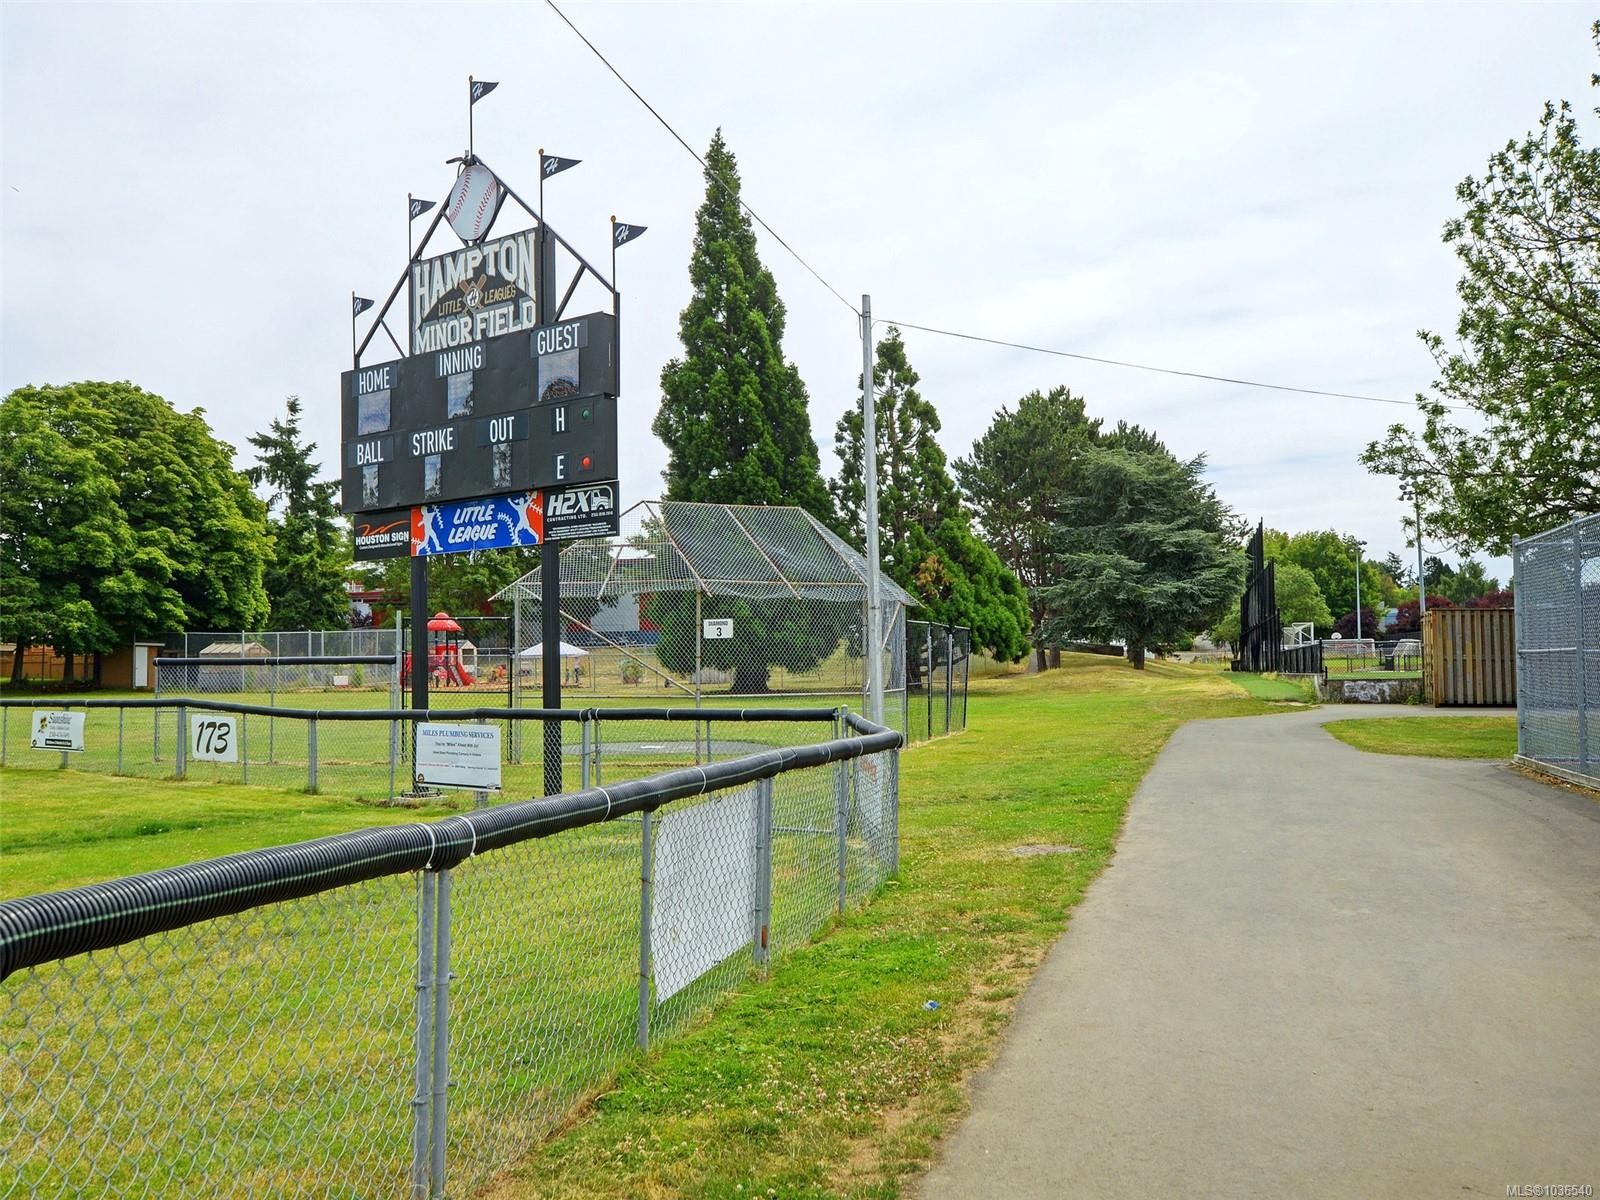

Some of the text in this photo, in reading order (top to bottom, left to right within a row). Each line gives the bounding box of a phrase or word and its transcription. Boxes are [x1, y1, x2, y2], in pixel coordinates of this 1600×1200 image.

[413, 230, 537, 330] HAMPTON
[438, 298, 462, 316] LITTLE
[414, 299, 537, 355] MINOR FIELD
[537, 323, 581, 355] GUEST
[440, 346, 482, 377] INNING
[359, 367, 391, 395] HOME
[489, 416, 515, 443] OUT
[555, 407, 565, 432] H
[357, 440, 384, 465] BALL
[412, 427, 454, 456] STRIKE
[556, 455, 565, 480] E
[453, 504, 496, 525] LITTLE
[547, 490, 591, 517] H2X
[355, 534, 390, 546] HOUSTON
[391, 531, 410, 542] SIGN
[447, 523, 499, 544] LEAGUE
[716, 627, 722, 637] 3
[196, 720, 231, 754] 173
[422, 729, 494, 739] MILES PLUMBING SERVICES
